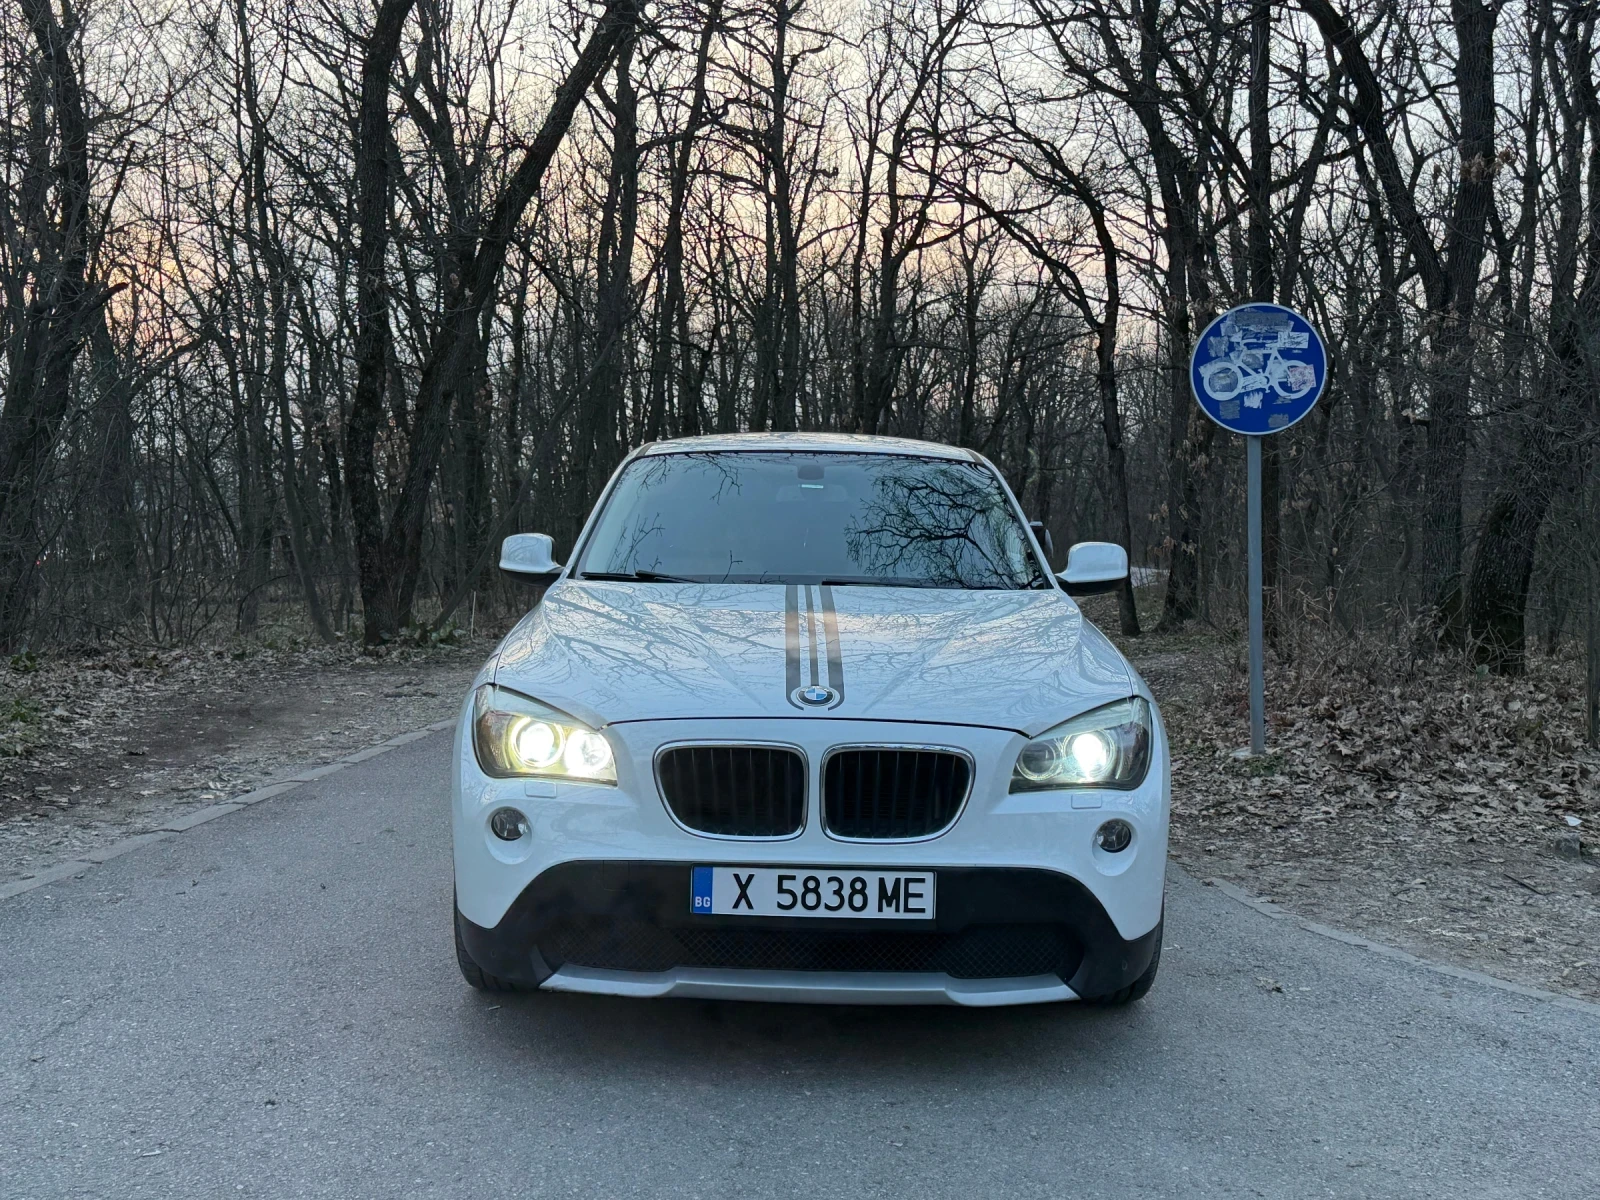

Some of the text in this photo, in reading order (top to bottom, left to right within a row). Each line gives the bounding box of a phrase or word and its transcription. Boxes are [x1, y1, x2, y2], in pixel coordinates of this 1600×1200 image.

[694, 896, 711, 908] BG
[732, 873, 926, 913] X 5838 ME
